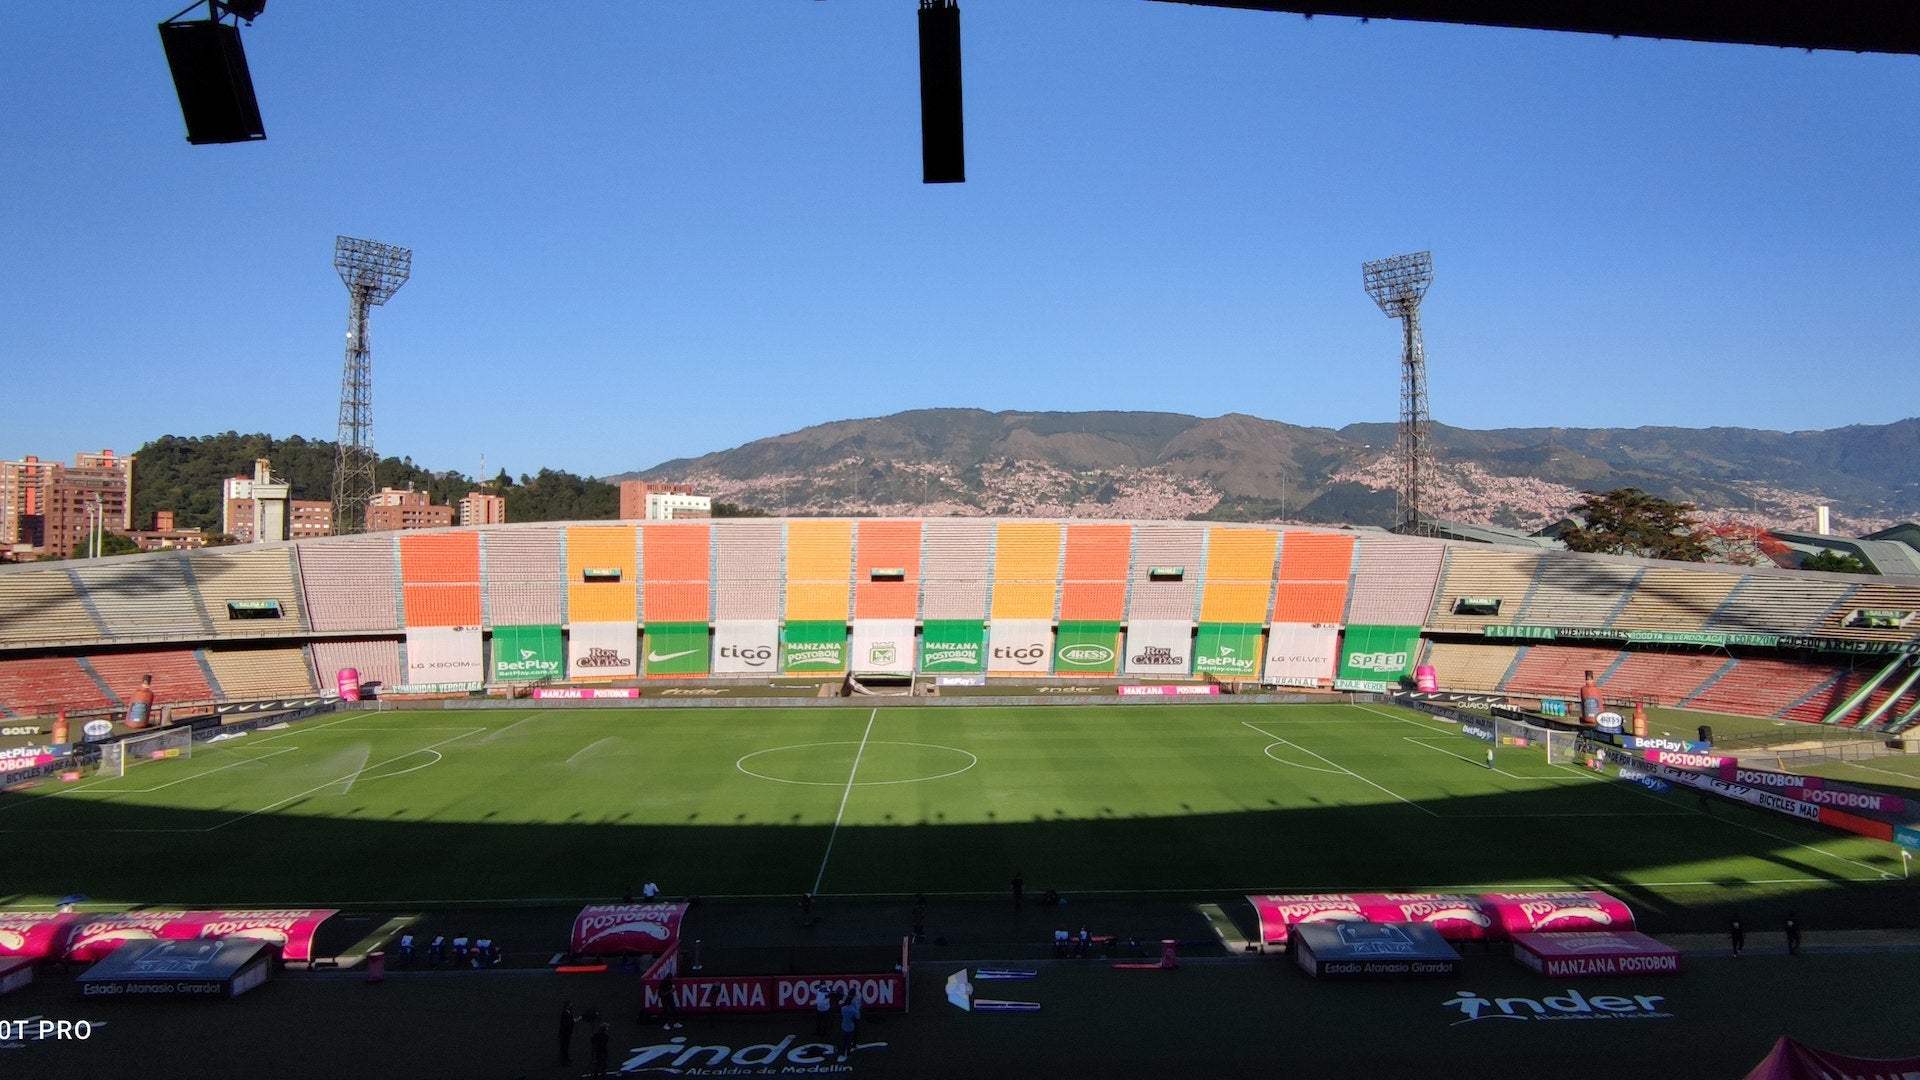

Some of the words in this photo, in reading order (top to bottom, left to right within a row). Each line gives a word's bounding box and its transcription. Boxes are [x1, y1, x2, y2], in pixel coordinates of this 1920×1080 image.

[925, 642, 979, 650] MANZANA
[787, 650, 839, 665] POSTOBON
[925, 650, 976, 664] POSTOBON
[1197, 656, 1253, 668] BetPlay
[1289, 656, 1328, 664] VELVET
[1350, 654, 1406, 666] SPEED
[497, 659, 559, 671] BetPlay
[1197, 665, 1253, 673] BetPlay.com.co
[392, 684, 438, 694] COMUNIDAD
[439, 682, 482, 693] VERDOLAGA
[1123, 687, 1164, 695] MANZANA
[1176, 686, 1211, 695] POSTOBON
[1363, 681, 1385, 691] VERDE
[540, 689, 582, 698] MANZANA
[593, 689, 630, 698] POSTOBON
[1457, 701, 1489, 710] GUAYOS
[1, 726, 40, 736] GOLTY
[1635, 737, 1681, 752] BetPlay
[1659, 751, 1720, 768] POSTOBON
[6, 767, 41, 784] BICYCLES
[1619, 768, 1659, 789] BetPlay
[1736, 769, 1804, 787] POSTOBON
[1802, 788, 1881, 810] POSTOBON
[1759, 793, 1796, 812] BICYCLES
[1799, 804, 1819, 819] MAD
[219, 911, 312, 919] MANZANA
[1278, 902, 1362, 924] POSTOBON
[1399, 900, 1482, 922] POSTOBON
[1520, 900, 1603, 924] POSTOBON
[200, 918, 299, 939] POSTOBON
[581, 911, 672, 939] POSTOBON
[66, 919, 171, 947] POSTOBON
[1324, 962, 1362, 974] Estadio
[1363, 962, 1409, 973] Atanasio
[1411, 962, 1453, 973] Girardot
[1548, 958, 1617, 975] MANZANA
[1618, 956, 1677, 972] POSTOBON
[83, 983, 122, 995] Estadio
[126, 982, 174, 994] Atanasio
[176, 982, 221, 993] Girardot
[756, 1067, 777, 1076] de
